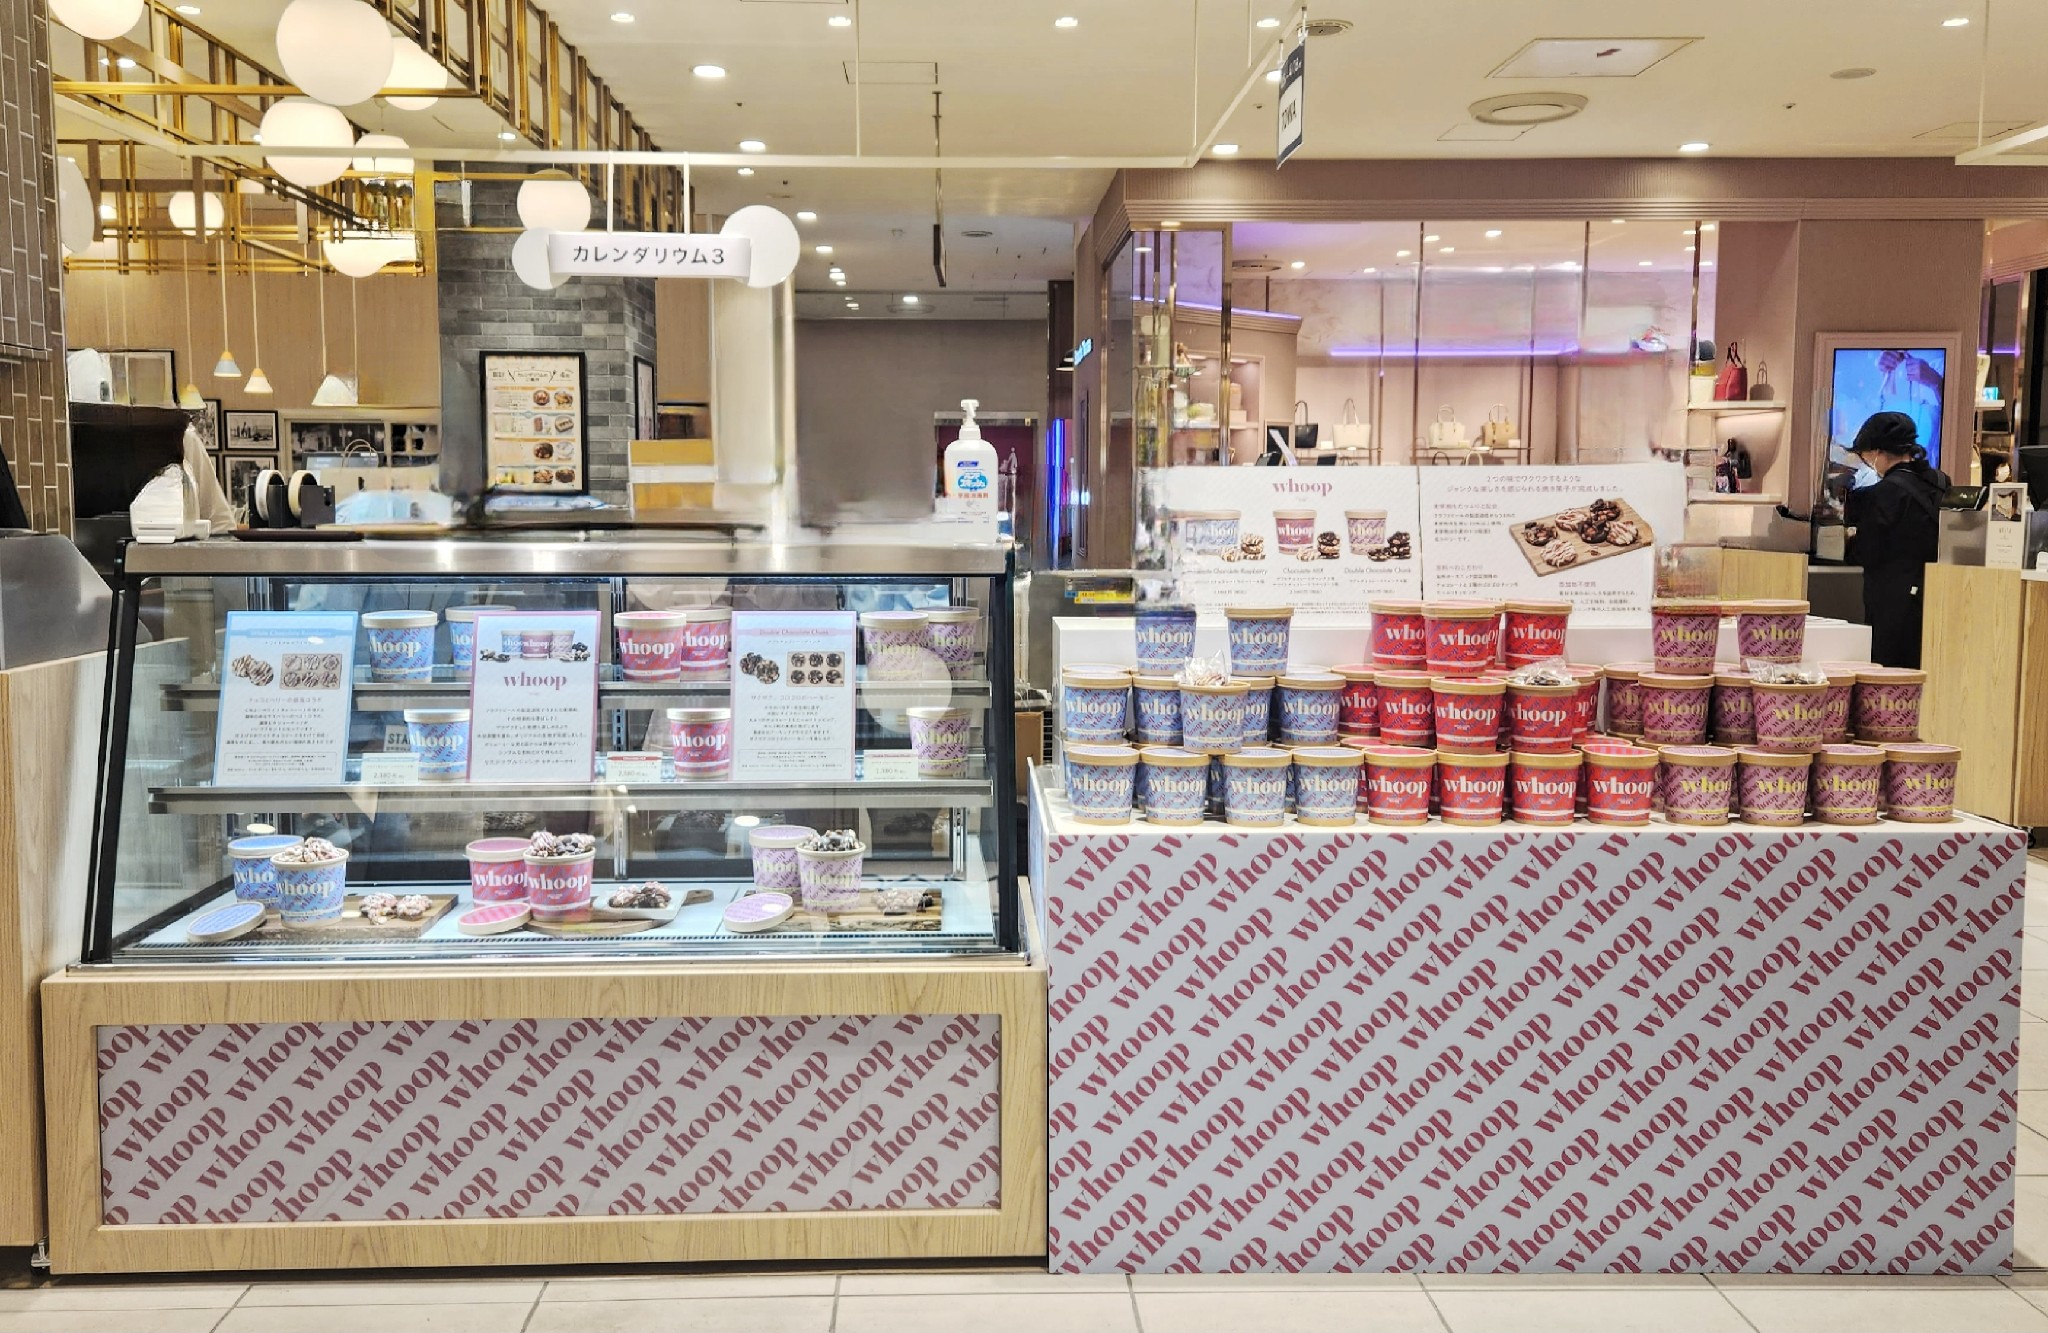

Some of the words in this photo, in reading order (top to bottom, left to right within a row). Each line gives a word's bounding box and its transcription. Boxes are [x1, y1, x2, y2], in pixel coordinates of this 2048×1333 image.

[573, 245, 724, 264] カレンダリウム3
[1272, 478, 1333, 496] whoop
[504, 671, 567, 690] whoop
[1137, 628, 1193, 648] whoop
[1230, 627, 1287, 648] whoop
[1066, 696, 1121, 718] whoop
[1186, 704, 1245, 725] whoop
[1284, 697, 1340, 719] whoop
[1436, 702, 1497, 726] whoop
[1072, 773, 1131, 796] whoop
[1149, 774, 1206, 796] whoop
[1299, 774, 1357, 797] whoop
[1369, 775, 1427, 798] whoop
[1444, 775, 1504, 797] whoop
[1515, 775, 1577, 798] whoop
[528, 873, 588, 892] whoop
[1054, 863, 1152, 955] whoop
[1121, 853, 1218, 944] whoop
[1289, 850, 1388, 940] whoop
[1354, 840, 1455, 931] whoop
[1498, 862, 1599, 953] whoop
[1565, 851, 1666, 943] whoop
[1736, 848, 1837, 940] whoop
[1802, 838, 1904, 930] whoop
[1110, 917, 1207, 1009] whoop
[1176, 908, 1273, 998] whoop
[1257, 937, 1355, 1027] whoop
[1344, 904, 1443, 995] whoop
[1410, 895, 1509, 986] whoop
[1553, 917, 1653, 1008] whoop
[1620, 907, 1720, 998] whoop
[1702, 936, 1802, 1027] whoop
[1791, 903, 1890, 995] whoop
[1857, 894, 1958, 985] whoop
[1191, 946, 1288, 1037] whoop
[1311, 991, 1409, 1081] whoop
[1399, 959, 1498, 1049] whoop
[1465, 949, 1564, 1039] whoop
[1634, 946, 1735, 1037] whoop
[1756, 991, 1855, 1081] whoop
[1844, 958, 1945, 1048] whoop
[1911, 949, 2013, 1039] whoop
[798, 1040, 895, 1131] whoop
[1078, 1005, 1176, 1096] whoop
[1093, 1043, 1190, 1134] whoop
[1159, 1033, 1256, 1124] whoop
[1246, 1001, 1343, 1092] whoop
[1366, 1045, 1465, 1136] whoop
[1454, 1013, 1553, 1104] whoop
[1520, 1003, 1619, 1094] whoop
[1534, 1042, 1634, 1133] whoop
[1601, 1033, 1701, 1123] whoop
[1689, 1000, 1789, 1092] whoop
[1810, 1045, 1910, 1135] whoop
[1898, 1013, 1999, 1103] whoop
[111, 1069, 210, 1162] whoop
[285, 1062, 383, 1154] whoop
[351, 1050, 450, 1142] whoop
[498, 1069, 595, 1161] whoop
[565, 1057, 662, 1149] whoop
[648, 1085, 743, 1176] whoop
[733, 1051, 830, 1142] whoop
[855, 1094, 950, 1183] whoop
[1214, 1087, 1311, 1177] whoop
[1301, 1055, 1398, 1145] whoop
[1589, 1096, 1689, 1186] whoop
[1655, 1087, 1755, 1177] whoop
[1743, 1054, 1843, 1145] whoop
[130, 1107, 227, 1200] whoop
[196, 1096, 294, 1188] whoop
[343, 1115, 441, 1206] whoop
[411, 1103, 508, 1195] whoop
[580, 1096, 677, 1188] whoop
[789, 1103, 885, 1194] whoop
[1063, 1130, 1159, 1220] whoop
[1149, 1097, 1245, 1187] whoop
[1268, 1141, 1366, 1231] whoop
[1355, 1109, 1453, 1199] whoop
[1421, 1099, 1520, 1189] whoop
[1436, 1138, 1534, 1227] whoop
[1502, 1129, 1600, 1218] whoop
[1710, 1141, 1809, 1230] whoop
[1798, 1109, 1898, 1199] whoop
[1865, 1100, 1964, 1189] whoop
[1878, 1138, 1979, 1227] whoop
[1117, 1184, 1214, 1274] whoop
[1202, 1151, 1300, 1241] whoop
[1556, 1182, 1655, 1271] whoop
[1644, 1151, 1743, 1240] whoop
